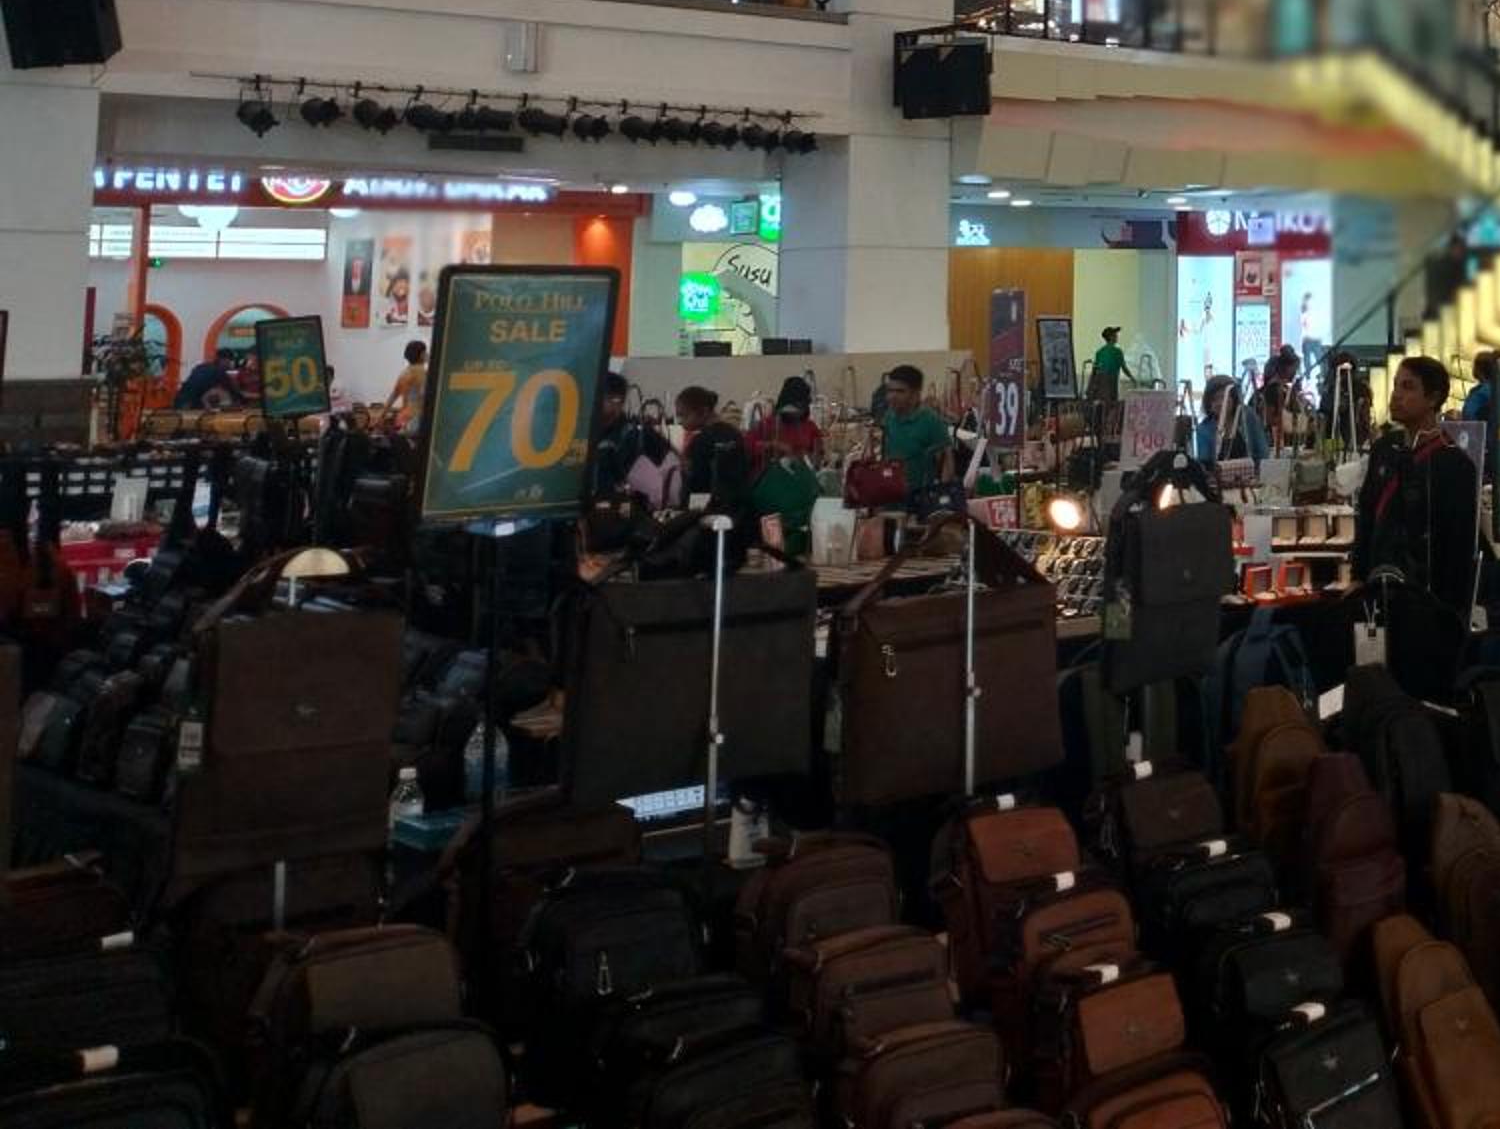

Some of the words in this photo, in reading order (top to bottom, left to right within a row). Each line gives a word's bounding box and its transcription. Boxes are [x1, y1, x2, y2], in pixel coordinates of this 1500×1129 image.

[489, 318, 567, 343] SALE
[264, 356, 318, 399] 50
[448, 368, 580, 473] 70
[995, 382, 1019, 437] 39
